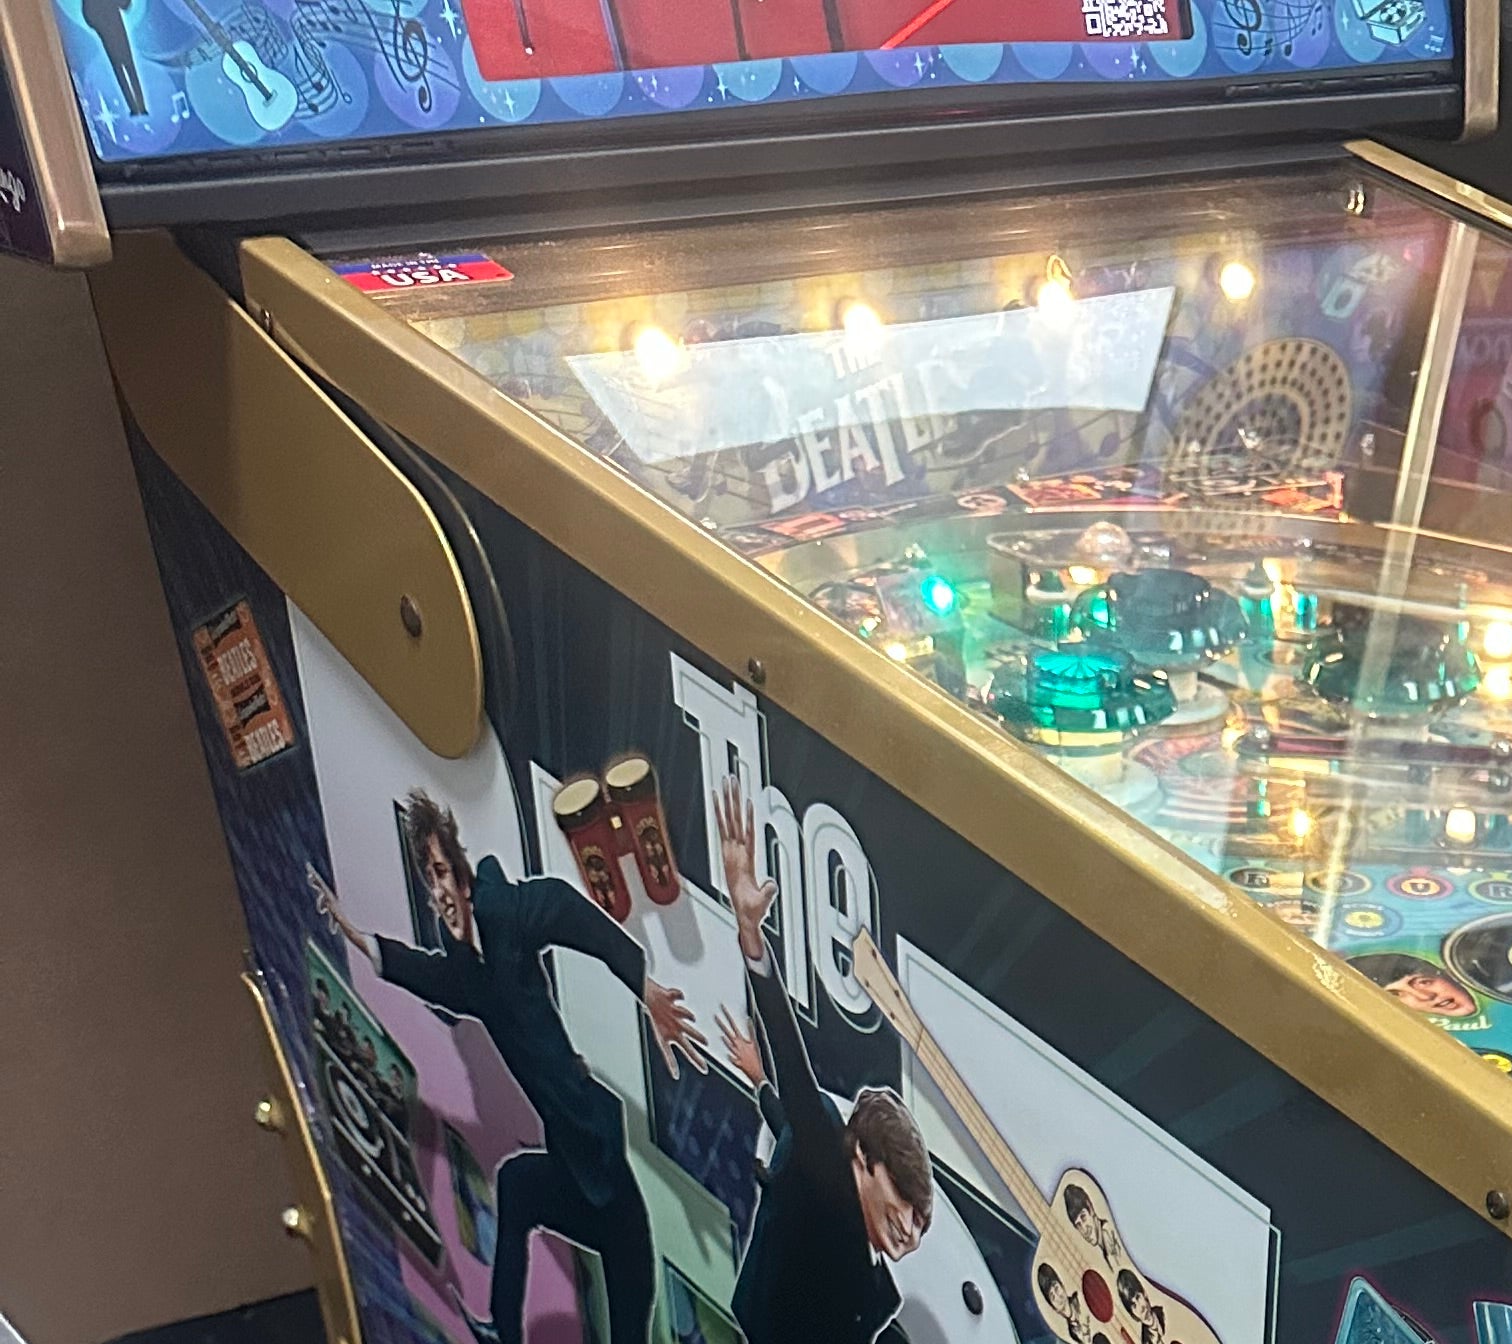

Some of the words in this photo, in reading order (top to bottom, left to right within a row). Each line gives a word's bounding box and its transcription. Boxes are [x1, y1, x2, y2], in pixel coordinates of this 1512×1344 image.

[381, 269, 469, 286] USA
[217, 637, 258, 686] BEATLES
[244, 719, 287, 764] BEATLES
[670, 652, 876, 1034] The
